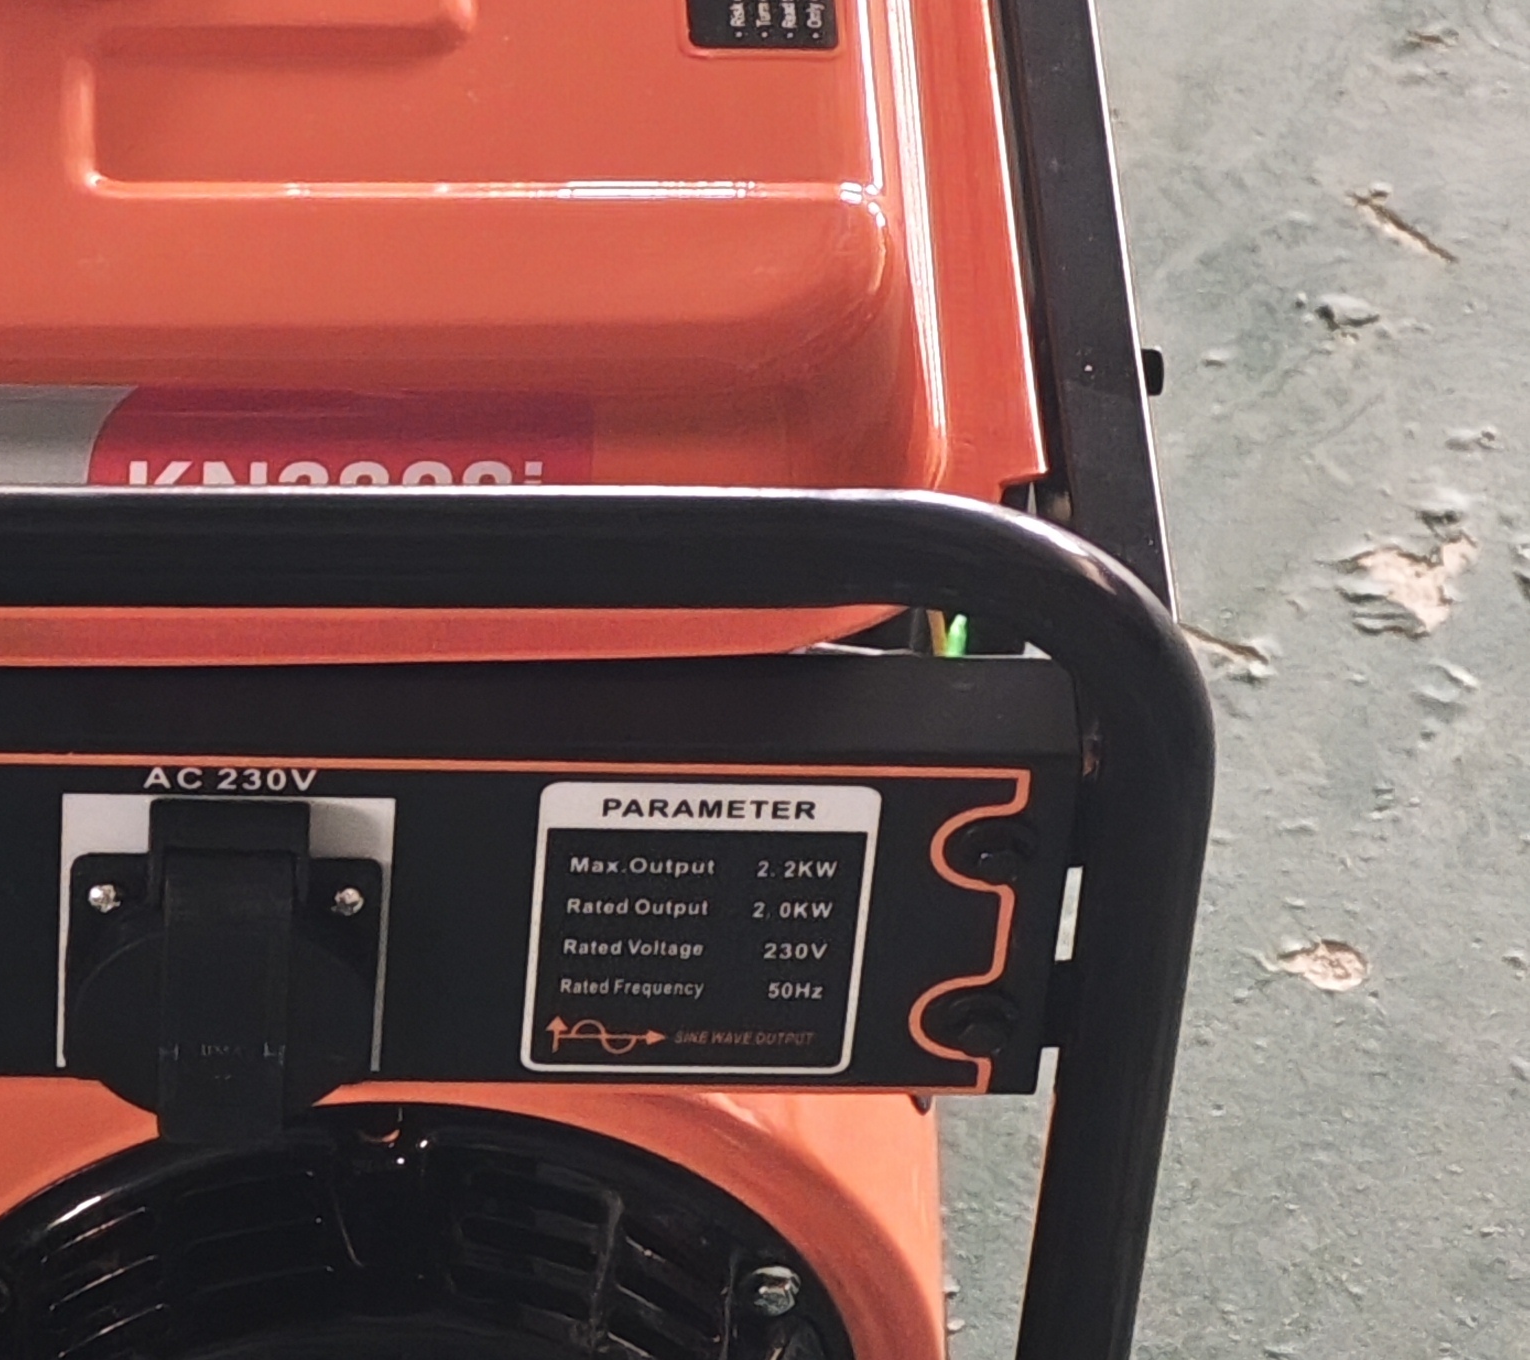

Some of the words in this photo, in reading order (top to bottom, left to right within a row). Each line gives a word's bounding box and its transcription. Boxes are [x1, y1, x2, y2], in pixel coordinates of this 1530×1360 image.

[143, 767, 203, 789] AC
[217, 768, 317, 791] 230V
[602, 798, 816, 820] PARAMETER
[567, 897, 629, 914] Rated
[635, 898, 709, 918] Output
[563, 939, 622, 955] Rated
[628, 939, 704, 959] Voltage
[764, 943, 828, 960] 230V
[560, 978, 609, 994] Rated
[614, 979, 704, 1000] Frequency
[768, 982, 823, 999] 50Hz
[711, 1031, 752, 1045] WAVE
[755, 1032, 814, 1046] OUTPUT
